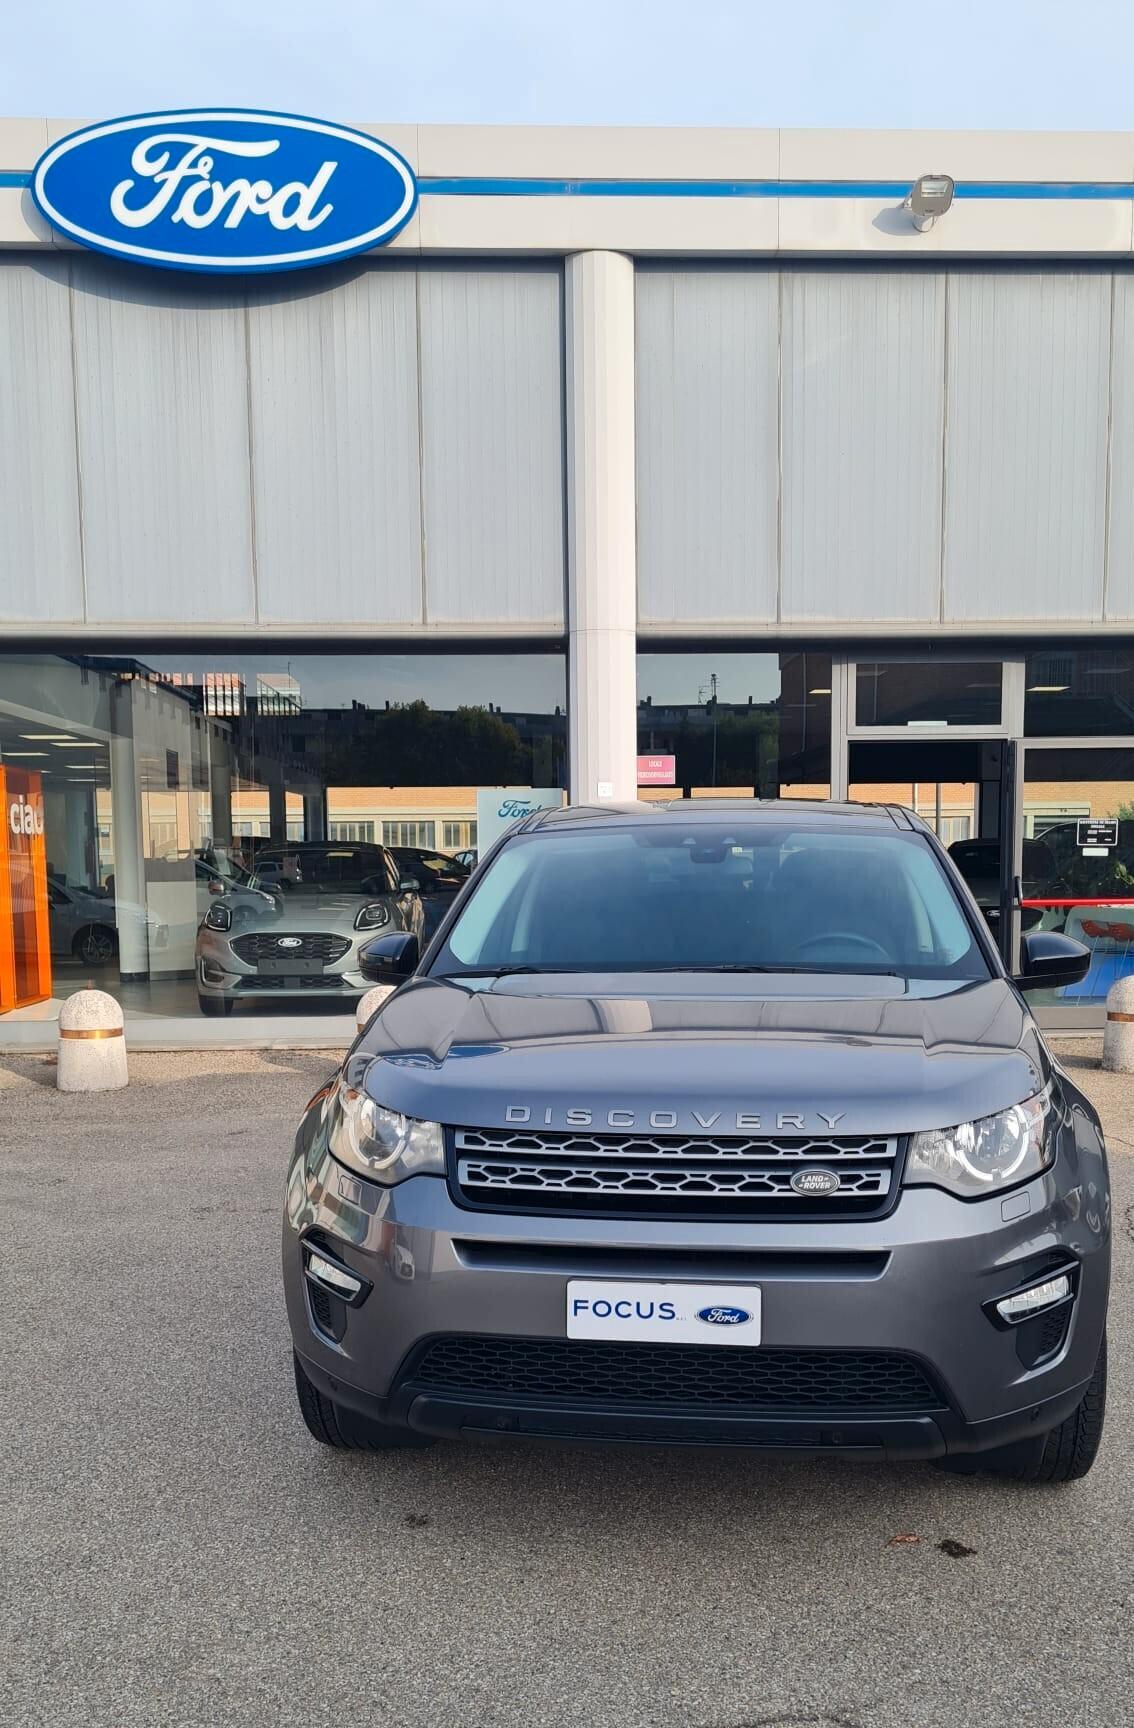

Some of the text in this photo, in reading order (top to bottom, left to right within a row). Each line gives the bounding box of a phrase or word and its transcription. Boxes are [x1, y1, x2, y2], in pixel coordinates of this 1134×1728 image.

[110, 133, 338, 231] Ford
[505, 1105, 847, 1130] DISCOVERY
[803, 1182, 831, 1190] ROVER
[573, 1299, 740, 1325] FOCUS Ford
